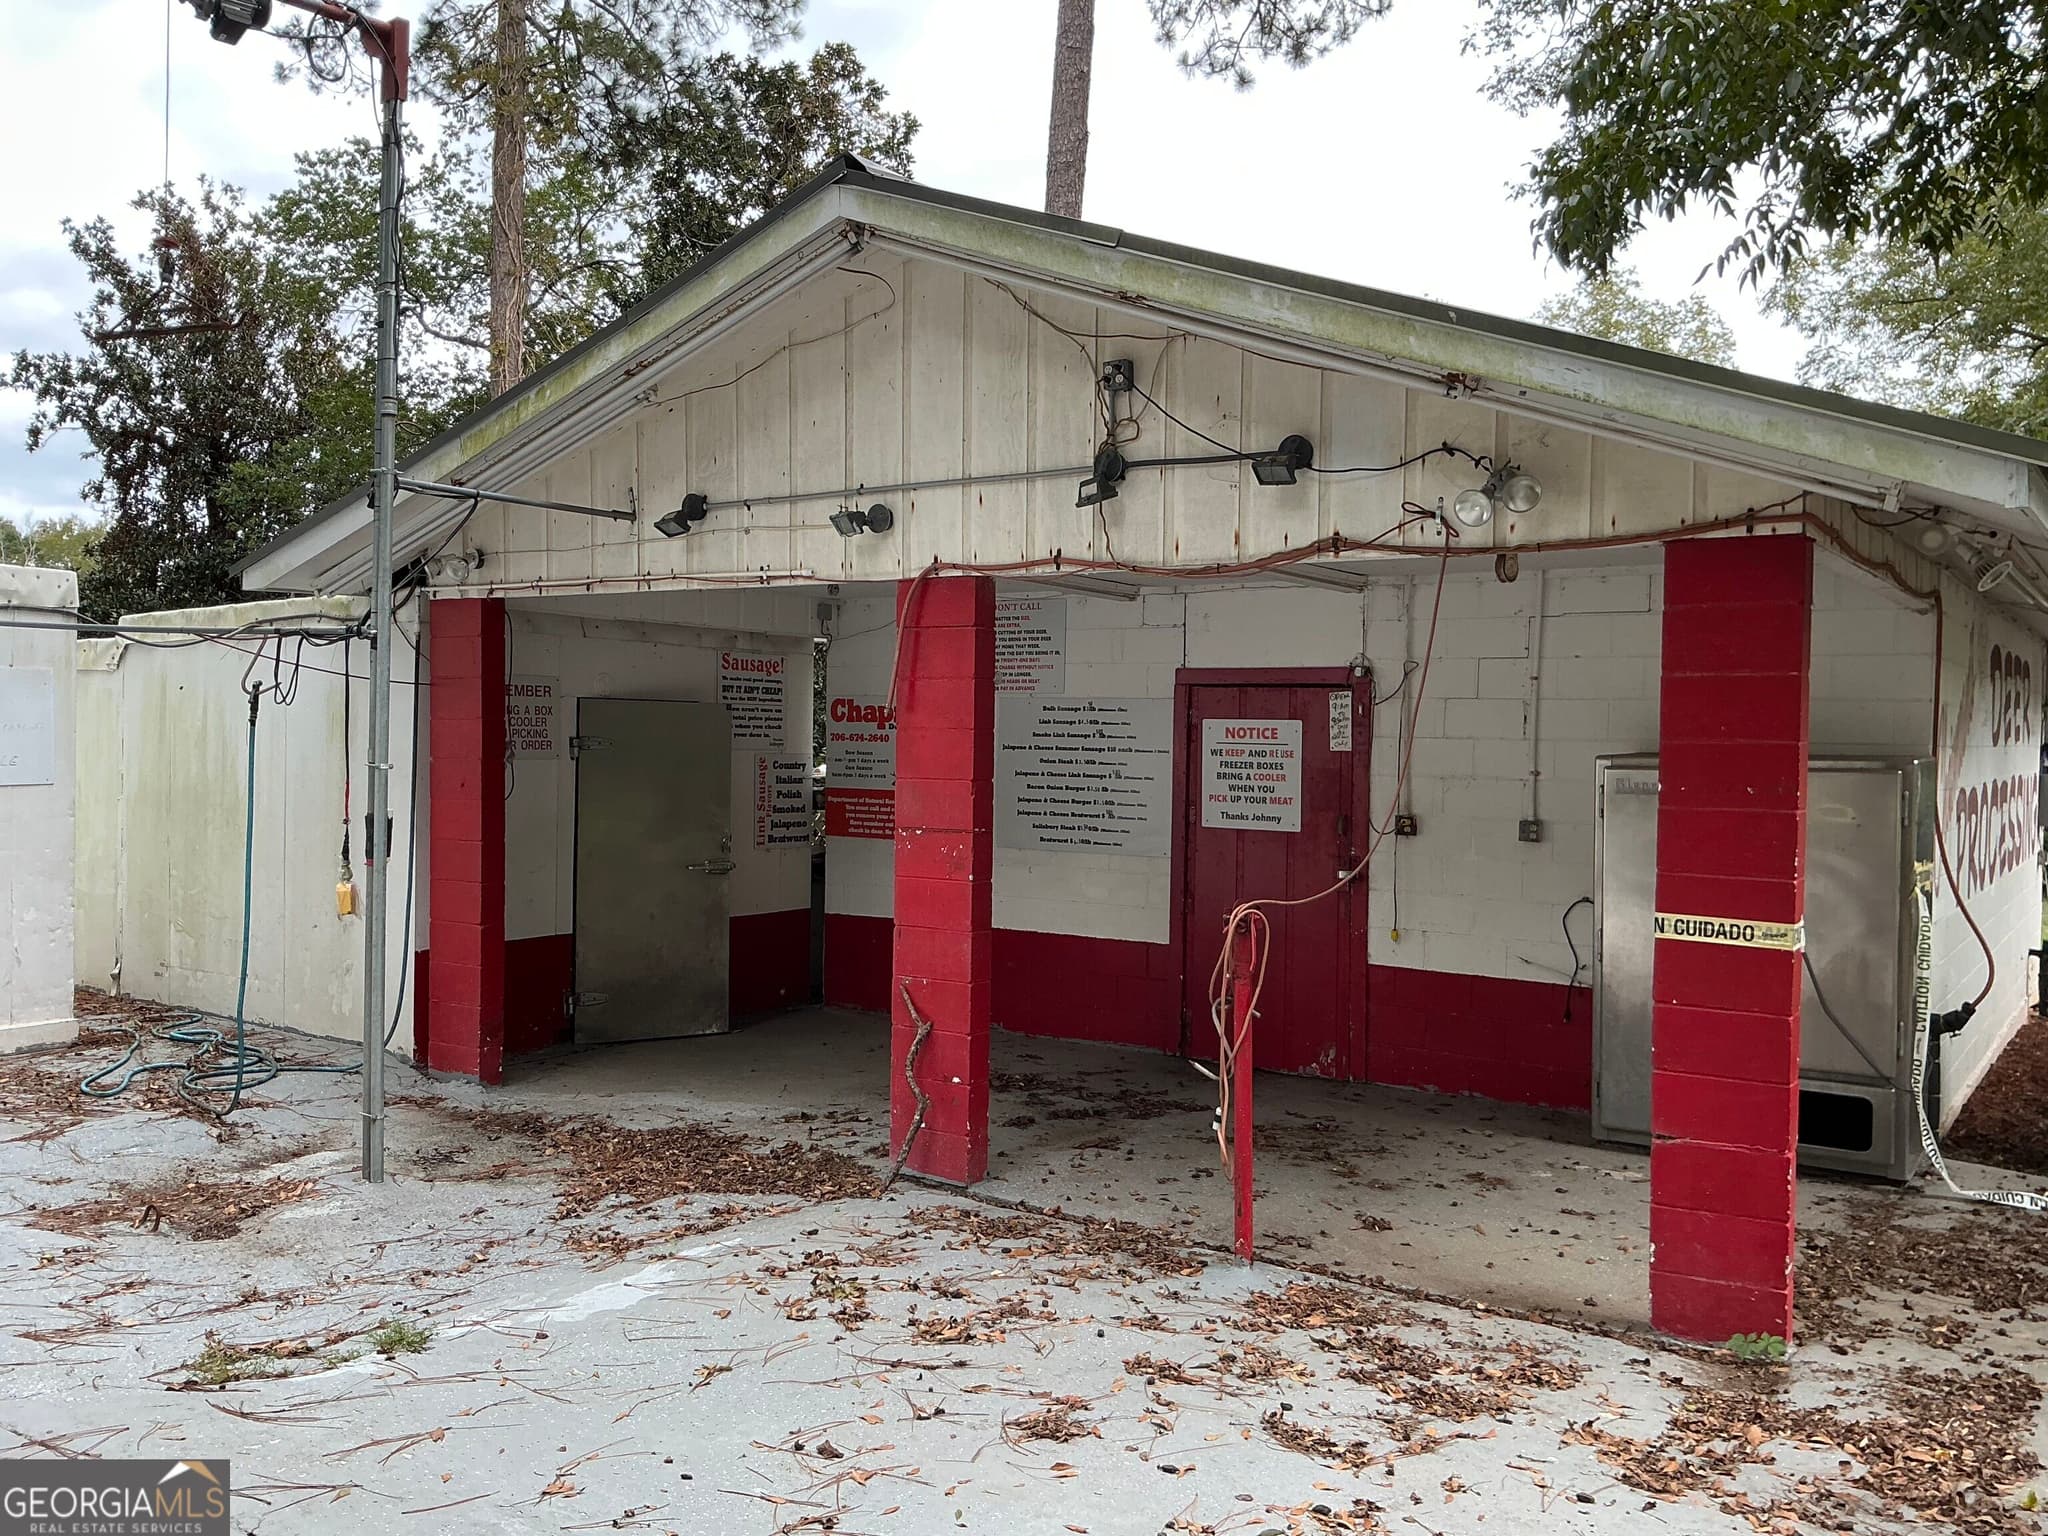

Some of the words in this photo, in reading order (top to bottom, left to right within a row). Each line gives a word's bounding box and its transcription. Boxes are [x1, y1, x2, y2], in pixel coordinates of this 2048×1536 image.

[1020, 602, 1042, 611] CALL
[721, 652, 784, 677] Sausage!
[722, 684, 735, 694] BUT
[735, 685, 742, 694] IT
[1989, 643, 2031, 748] DEER
[523, 704, 531, 715] A
[534, 705, 553, 716] BOX
[830, 697, 897, 730] Chap
[510, 716, 548, 727] COOLER
[512, 728, 549, 739] PICKING
[1224, 726, 1279, 739] NOTICE
[521, 740, 553, 751] ORDER
[1210, 749, 1224, 757] WE
[1224, 749, 1246, 758] KEEP
[1247, 750, 1267, 758] AND
[772, 760, 807, 772] Country
[1219, 760, 1254, 770] FREEZER
[1256, 761, 1285, 771] BOXES
[775, 775, 804, 785] Italian
[1216, 772, 1244, 781] BRING
[1244, 773, 1252, 781] A
[1252, 773, 1287, 782] COOLER
[757, 756, 768, 812] Sausage
[1227, 784, 1255, 793] WHEN
[1257, 785, 1275, 794] YOU
[776, 789, 803, 799] Polish
[1208, 794, 1228, 803] PICK
[1229, 795, 1242, 804] UP
[1243, 795, 1267, 805] YOUR
[1269, 796, 1294, 806] MEAT
[772, 803, 806, 813] Smoked
[1219, 811, 1249, 821] Thanks
[1250, 812, 1282, 825] Johnny
[756, 815, 767, 846] Link
[770, 819, 808, 831] Jalapeno
[767, 833, 811, 844] Bratwurst
[1956, 771, 2041, 904] PROCESSING
[1673, 918, 1756, 942] CUIDADO
